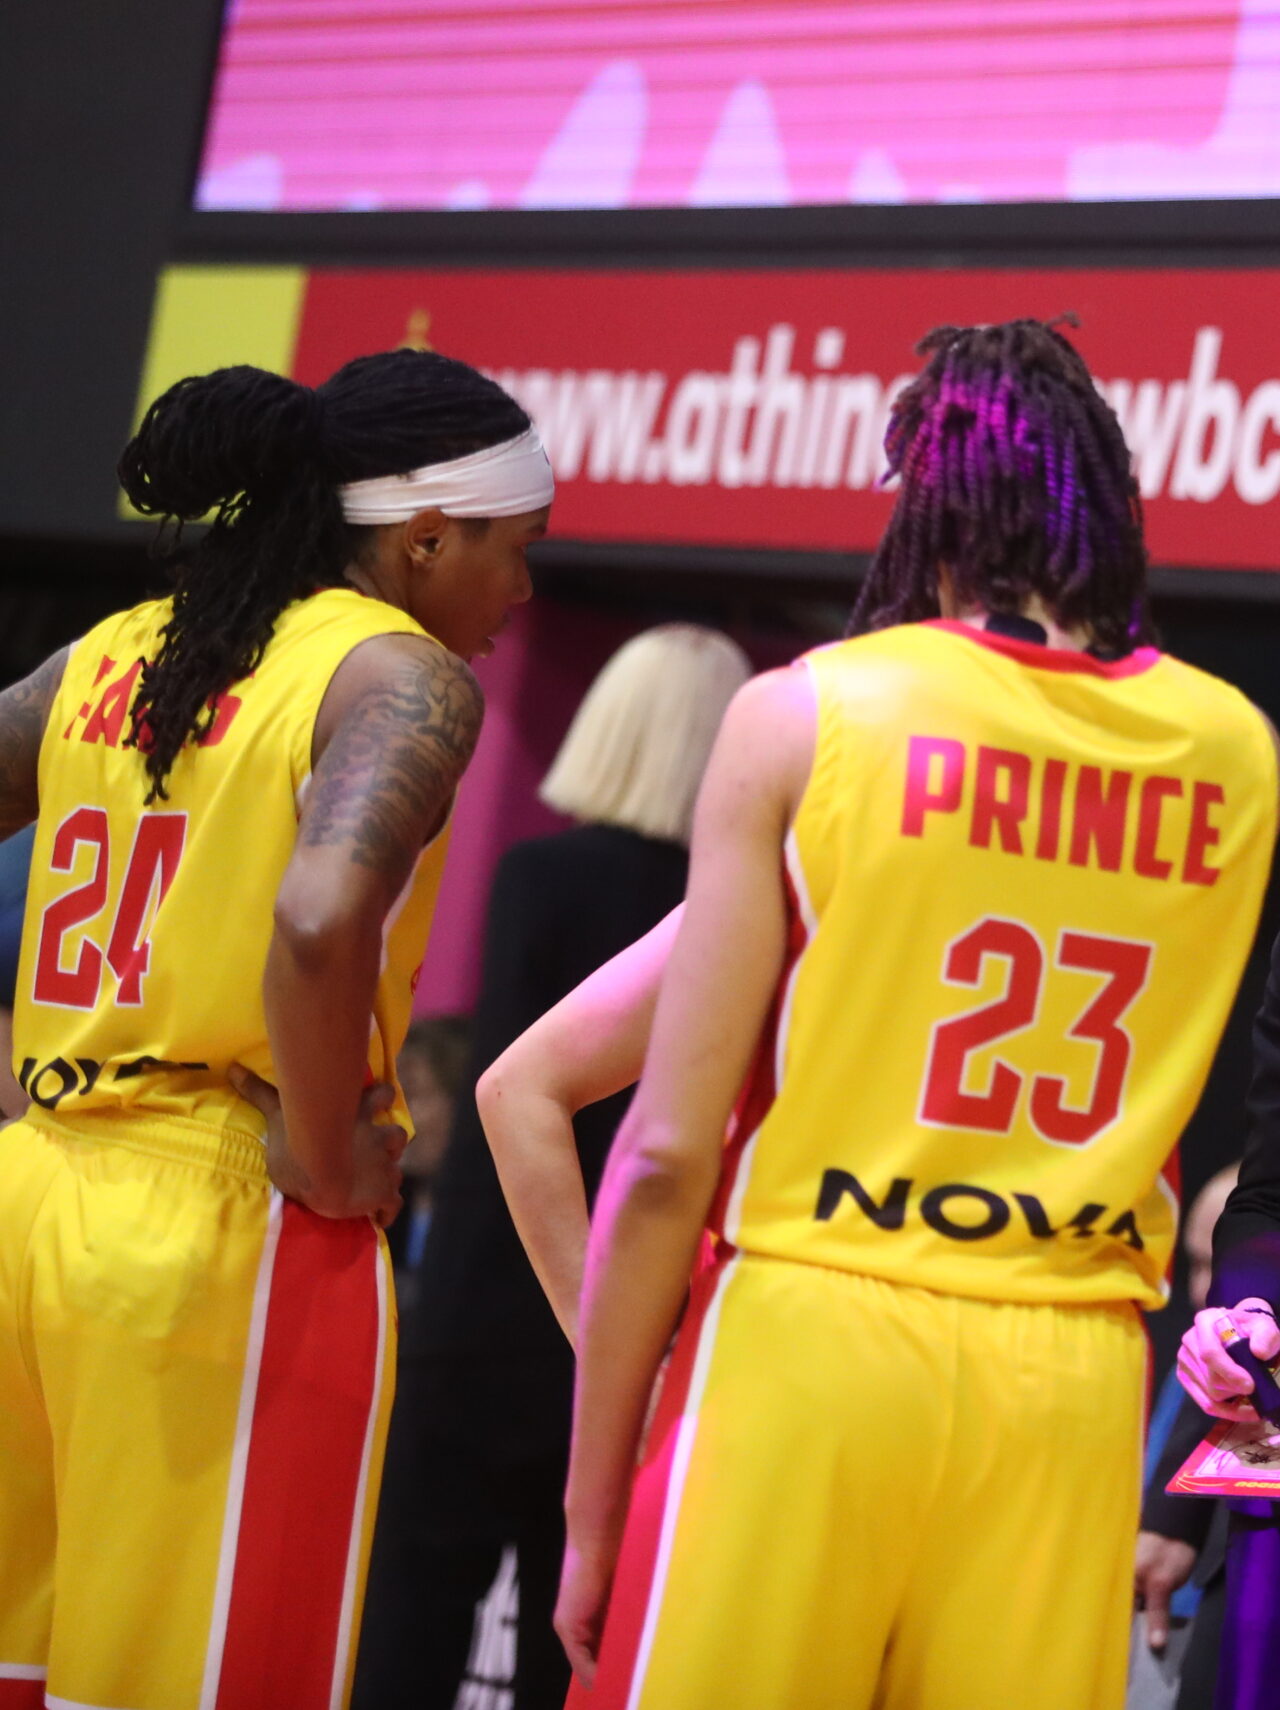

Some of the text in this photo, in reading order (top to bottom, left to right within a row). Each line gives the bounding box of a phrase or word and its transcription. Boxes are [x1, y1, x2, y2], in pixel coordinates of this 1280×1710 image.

[32, 805, 189, 1013] 24
[900, 735, 1225, 887] PRINCE
[916, 913, 1155, 1151] 23
